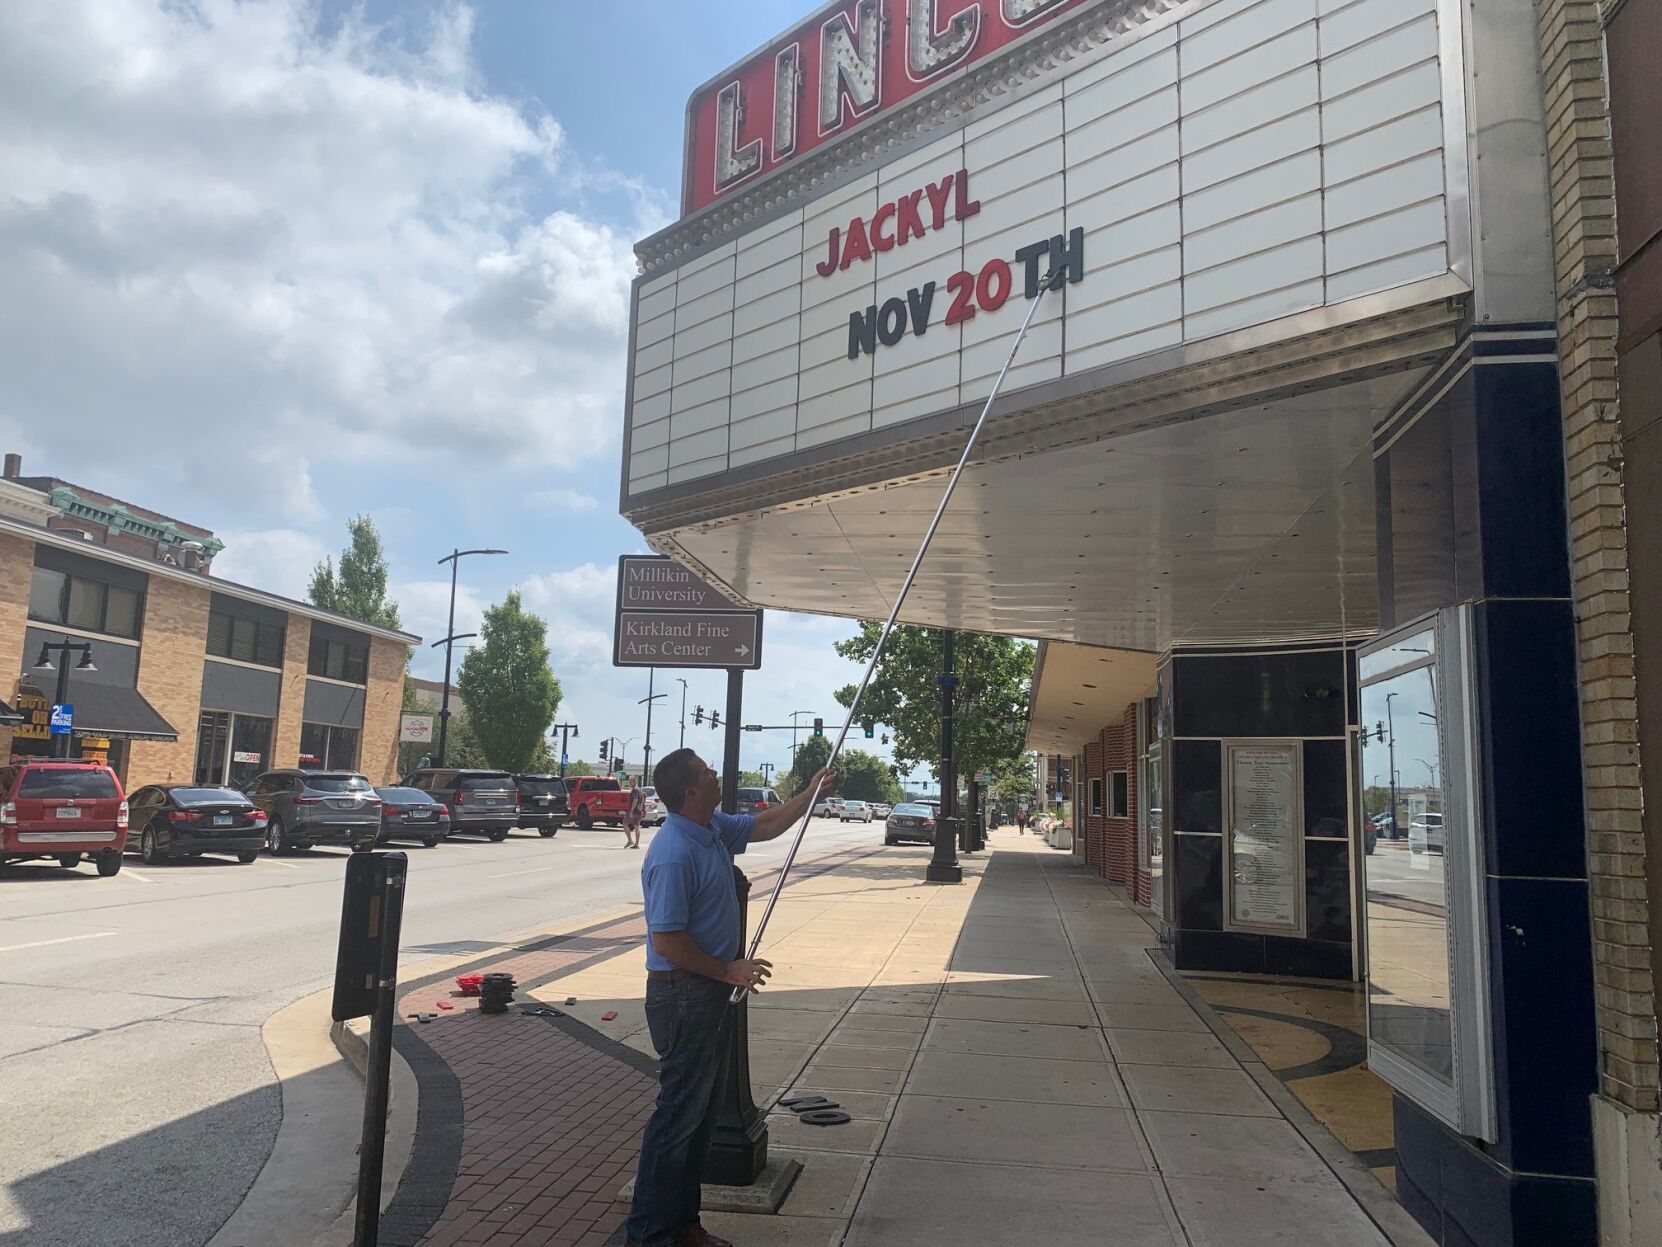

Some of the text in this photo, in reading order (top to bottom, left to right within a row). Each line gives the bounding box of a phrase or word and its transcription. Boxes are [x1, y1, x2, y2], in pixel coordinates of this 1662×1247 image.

[713, 0, 1071, 195] LINC
[816, 168, 980, 278] JACKYL
[847, 226, 1084, 360] NOV 20TH
[629, 567, 689, 583] Millikin
[629, 586, 706, 605] University
[626, 621, 730, 637] Kirkland Fine
[625, 640, 711, 656] Arts Center
[245, 754, 261, 762] OPEN
